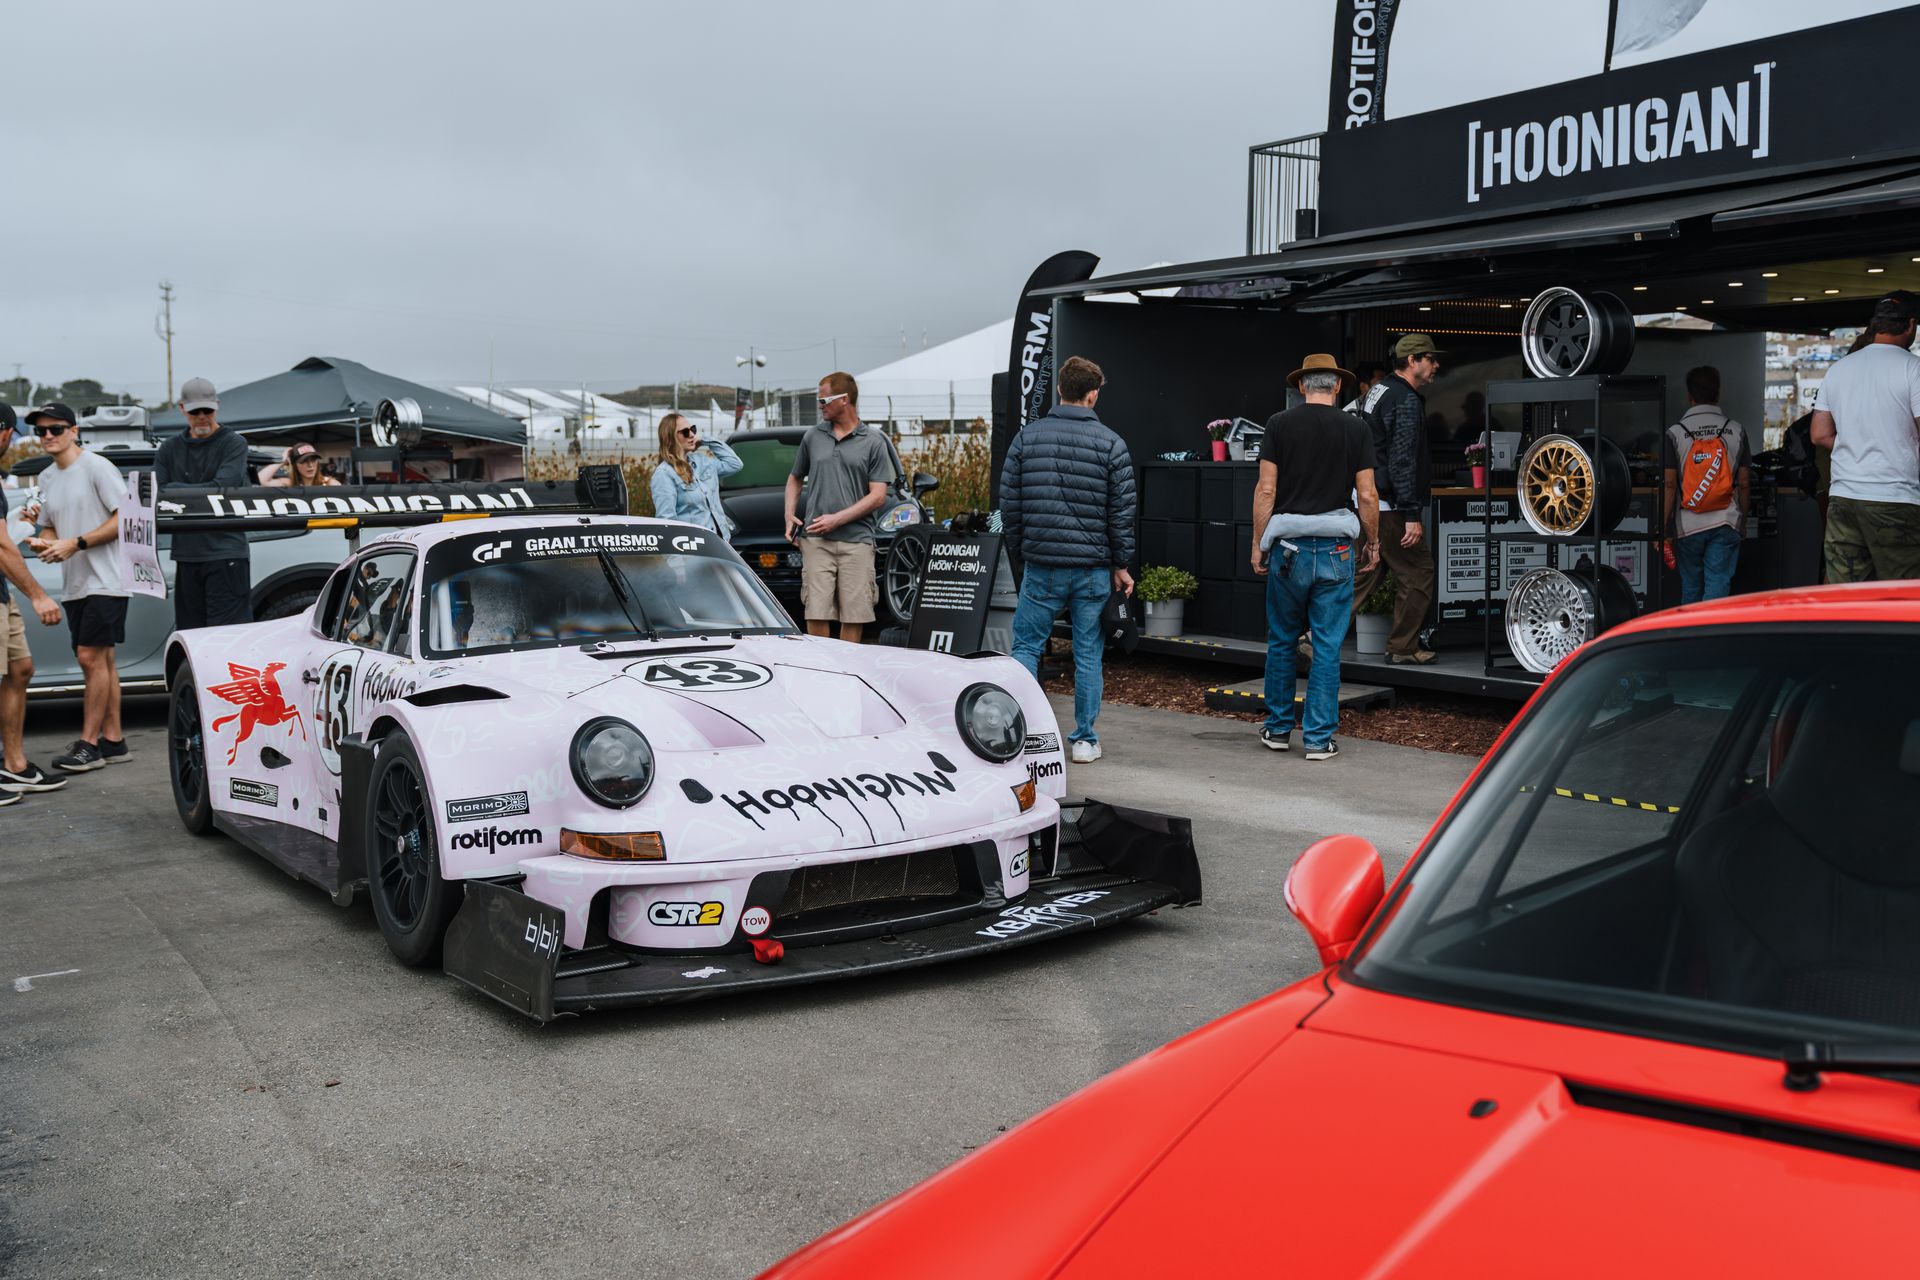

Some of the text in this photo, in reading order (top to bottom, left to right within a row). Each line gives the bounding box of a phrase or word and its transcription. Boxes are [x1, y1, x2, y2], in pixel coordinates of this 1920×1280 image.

[525, 536, 576, 552] GRAN
[931, 544, 980, 557] HOONIGAN
[644, 660, 762, 688] 43
[451, 825, 543, 854] rotiform
[648, 901, 724, 926] CSR2
[744, 917, 768, 926] TOW
